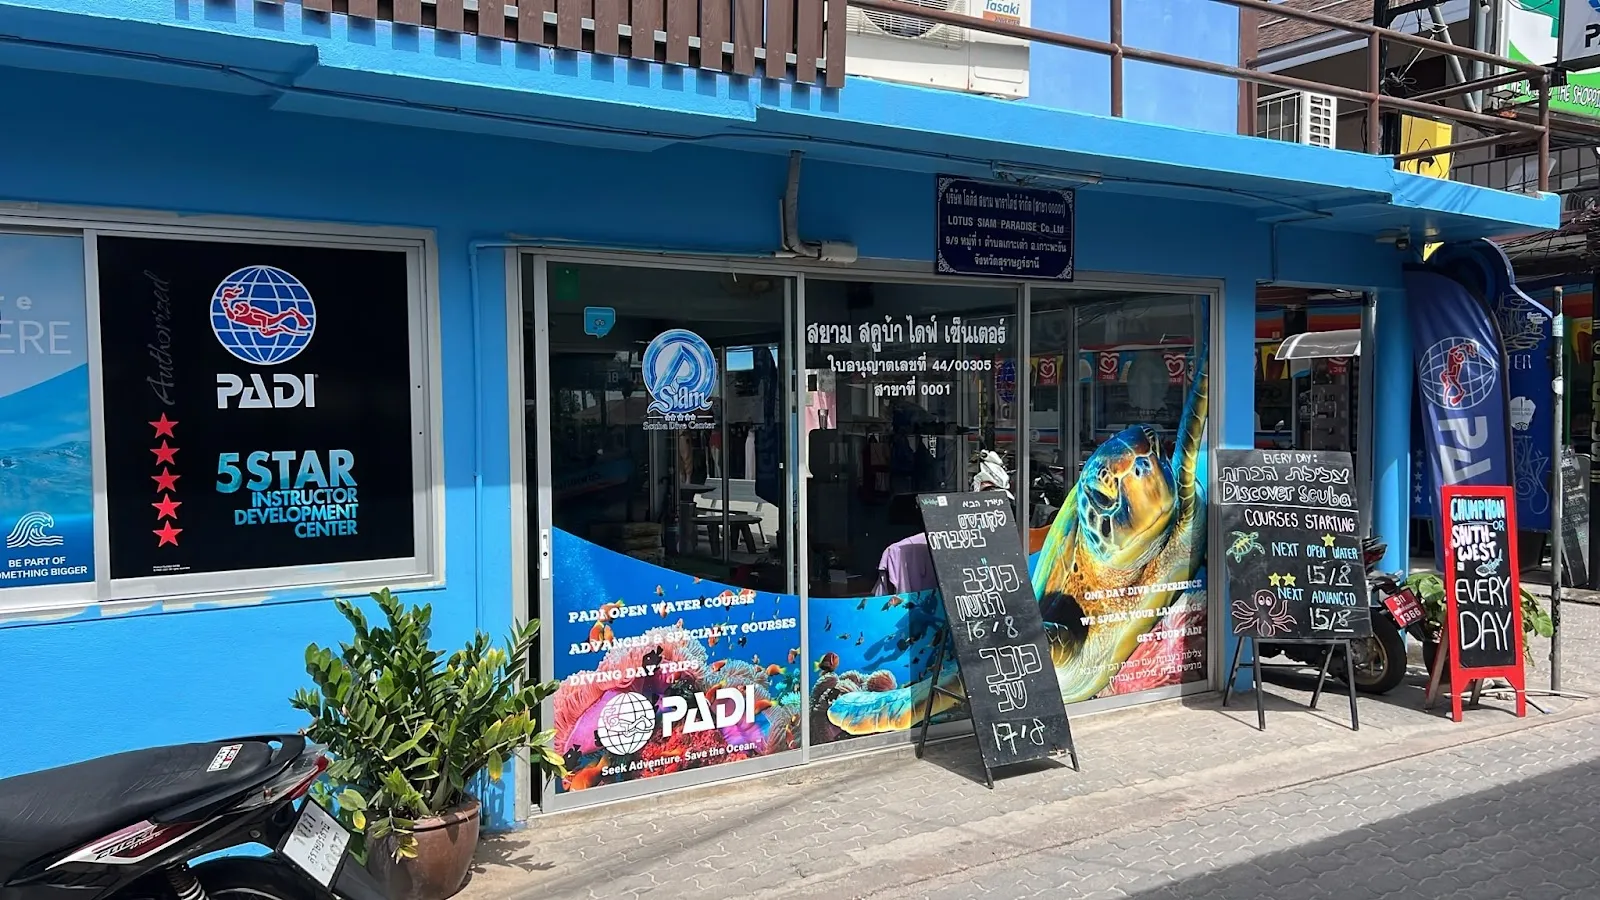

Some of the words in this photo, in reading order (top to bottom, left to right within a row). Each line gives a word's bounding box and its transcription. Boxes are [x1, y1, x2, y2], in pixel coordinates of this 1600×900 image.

[986, 0, 1020, 15] Tasaki
[947, 215, 973, 226] LOTUS
[977, 218, 997, 228] SIAM
[1000, 220, 1037, 232] PARADISE
[945, 236, 958, 246] 9/9
[0, 295, 33, 310] e
[143, 268, 175, 405] Authorized
[806, 321, 852, 345] สยาม
[858, 315, 903, 353] สคูบ้า
[906, 314, 938, 344] ไดฟ์
[945, 317, 1006, 344] เซ็นเตอร์
[827, 352, 927, 378] ใบอนุญาตเลขที่
[932, 359, 992, 372] 44/00305
[216, 373, 316, 409] PADI
[874, 376, 916, 397] สาขาที่
[921, 384, 950, 395] 0001
[647, 384, 713, 413] Siam
[642, 421, 668, 430] Scuba
[669, 421, 687, 430] Dive
[688, 421, 716, 430] Center
[1263, 453, 1292, 464] EVERY
[215, 452, 243, 494] 5
[247, 449, 358, 492] STAR
[252, 488, 358, 507] INSTRUCTOR
[1222, 482, 1295, 503] Discover
[1298, 486, 1351, 507] Scuba
[234, 504, 358, 526] DEVELOPMENT
[1244, 508, 1299, 528] COURSES
[1305, 514, 1355, 533] STARTING
[1451, 498, 1505, 521] CHUMPHON
[294, 522, 358, 538] CENTER
[1492, 520, 1504, 531] OR
[1271, 541, 1299, 558] NEXT
[1306, 545, 1326, 558] OPEN
[1332, 546, 1358, 560] WATER
[1457, 541, 1496, 561] WEST
[8, 560, 22, 568] BE
[24, 558, 50, 567] PART
[52, 557, 66, 565] OF
[51, 566, 88, 576] BIGGER
[1084, 591, 1105, 600] ONE
[1106, 588, 1126, 598] DAY
[1128, 585, 1150, 596] DIVE
[1152, 580, 1202, 593] EXPERIENCE
[1277, 586, 1304, 601] NEXT
[1312, 590, 1356, 606] ADVANCED
[1455, 576, 1510, 606] EVERY
[568, 610, 606, 623] PADI
[609, 604, 648, 619] OPEN
[651, 599, 701, 614] WATER
[704, 594, 755, 609] COURSE
[1080, 616, 1095, 626] WE
[1097, 612, 1128, 624] SPEAK
[1130, 609, 1154, 620] YOUR
[1156, 603, 1201, 616] LANGUAGE
[568, 635, 649, 655] ADVANCED
[653, 633, 664, 645] &
[667, 624, 738, 642] SPECIALTY
[741, 618, 796, 634] COURSES
[1137, 633, 1154, 643] GET
[1155, 629, 1178, 640] YOUR
[1180, 626, 1202, 637] PADI
[1459, 611, 1511, 651] DAY
[569, 669, 622, 687] DIVING
[625, 664, 656, 679] DAY
[660, 660, 699, 675] TRIPS
[662, 684, 755, 737] PADI
[601, 765, 627, 776] Seek
[630, 755, 682, 772] Adventure.
[684, 750, 708, 762] Save
[710, 746, 725, 757] the
[726, 742, 758, 754] Ocean.
